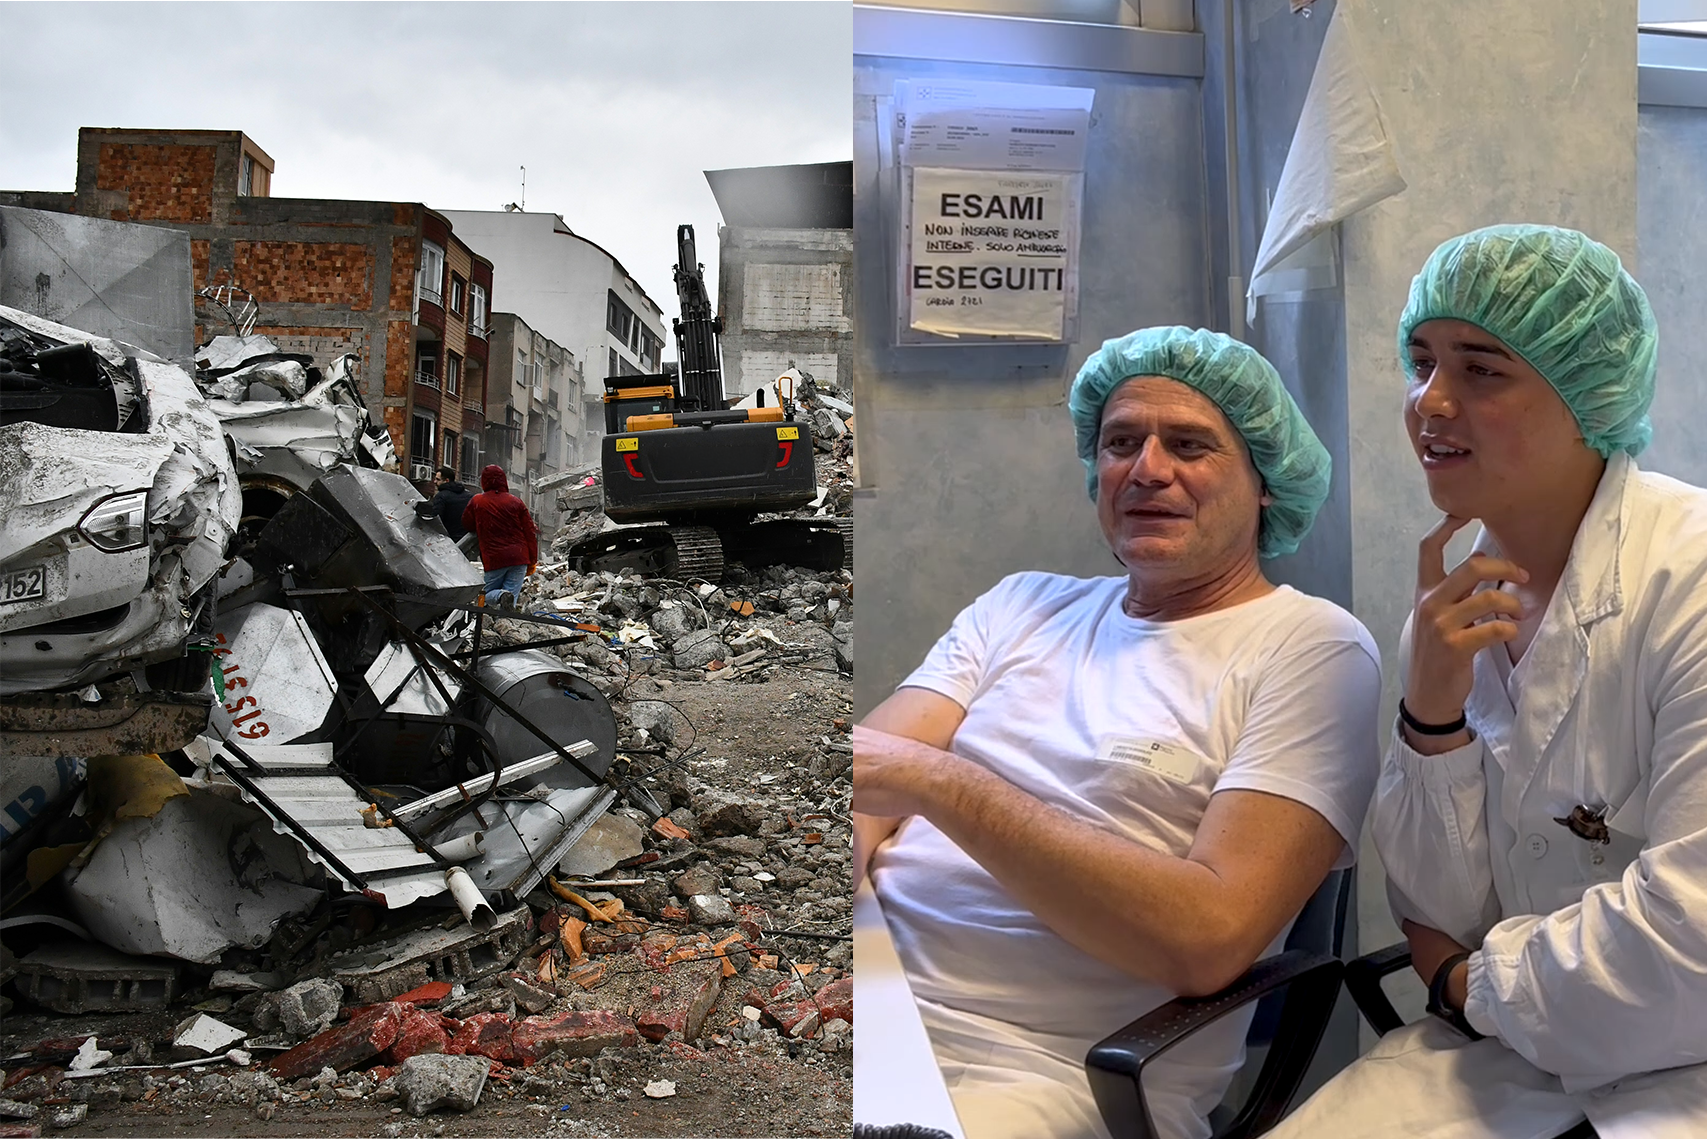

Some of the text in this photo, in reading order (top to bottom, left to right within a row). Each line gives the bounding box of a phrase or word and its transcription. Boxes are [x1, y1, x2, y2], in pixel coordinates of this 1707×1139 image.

[940, 193, 1043, 221] ESAMI
[924, 223, 953, 237] NON
[913, 265, 1063, 291] ESEGUITI
